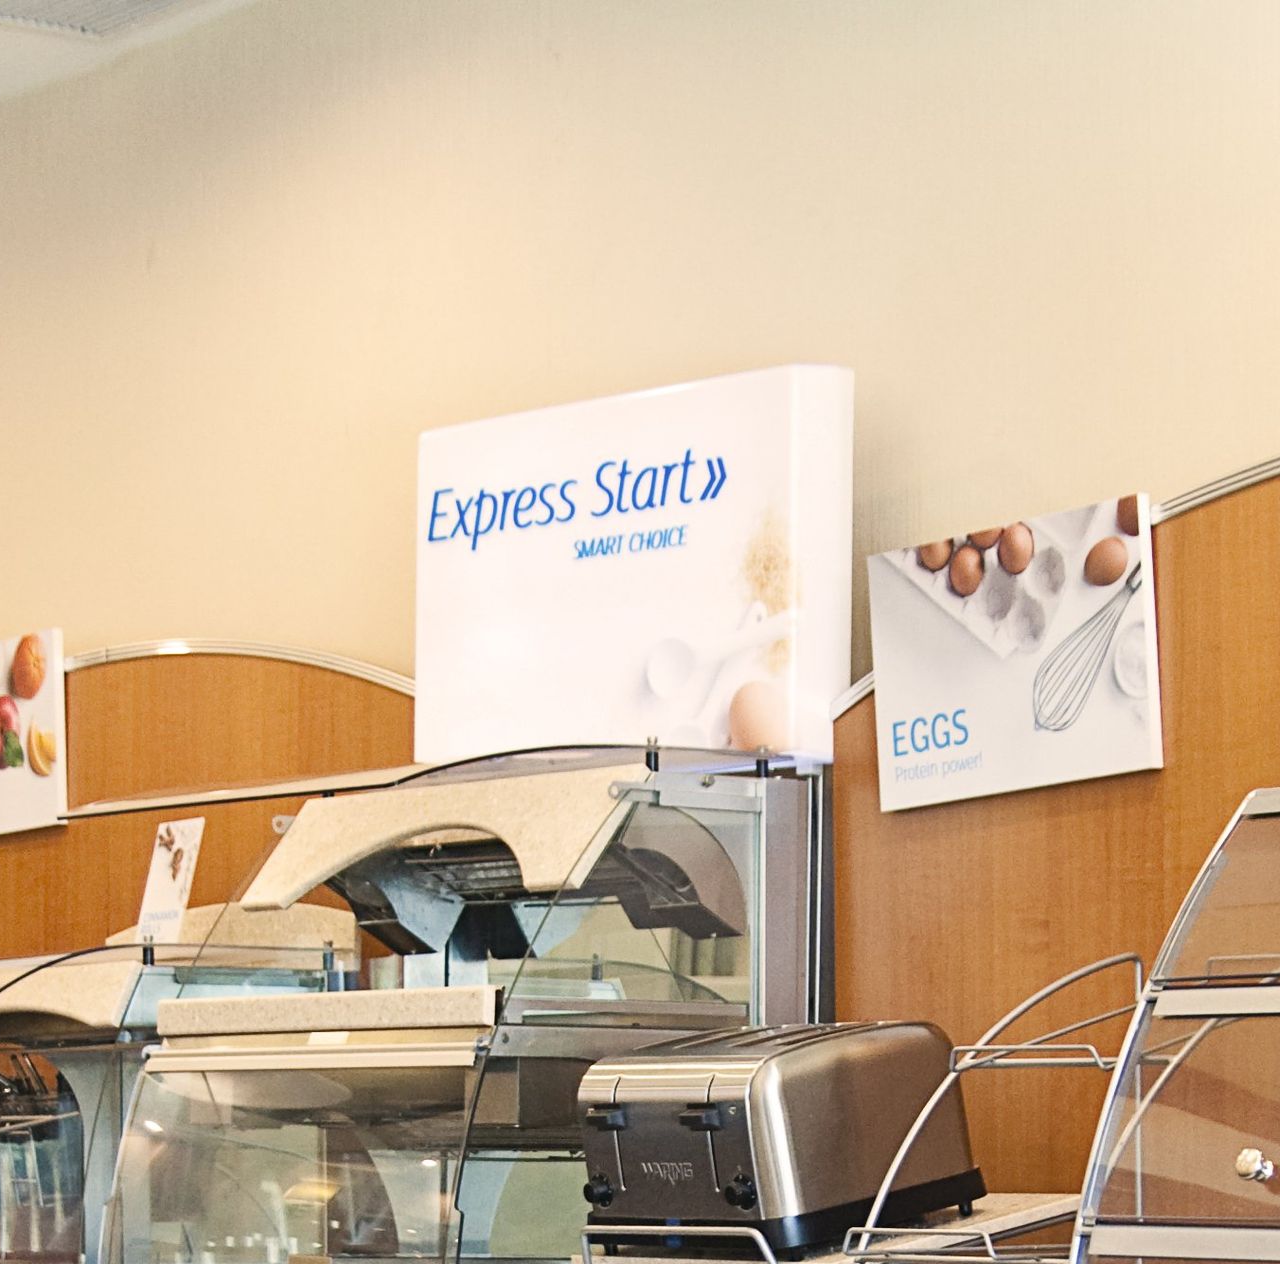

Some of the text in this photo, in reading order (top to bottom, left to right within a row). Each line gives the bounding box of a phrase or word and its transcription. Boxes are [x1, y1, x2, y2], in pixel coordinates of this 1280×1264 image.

[427, 478, 578, 552] Express
[573, 524, 689, 560] SMART CHOICE
[892, 708, 969, 757] EGGS
[895, 751, 983, 783] Protein power!
[641, 1162, 694, 1185] WARING
